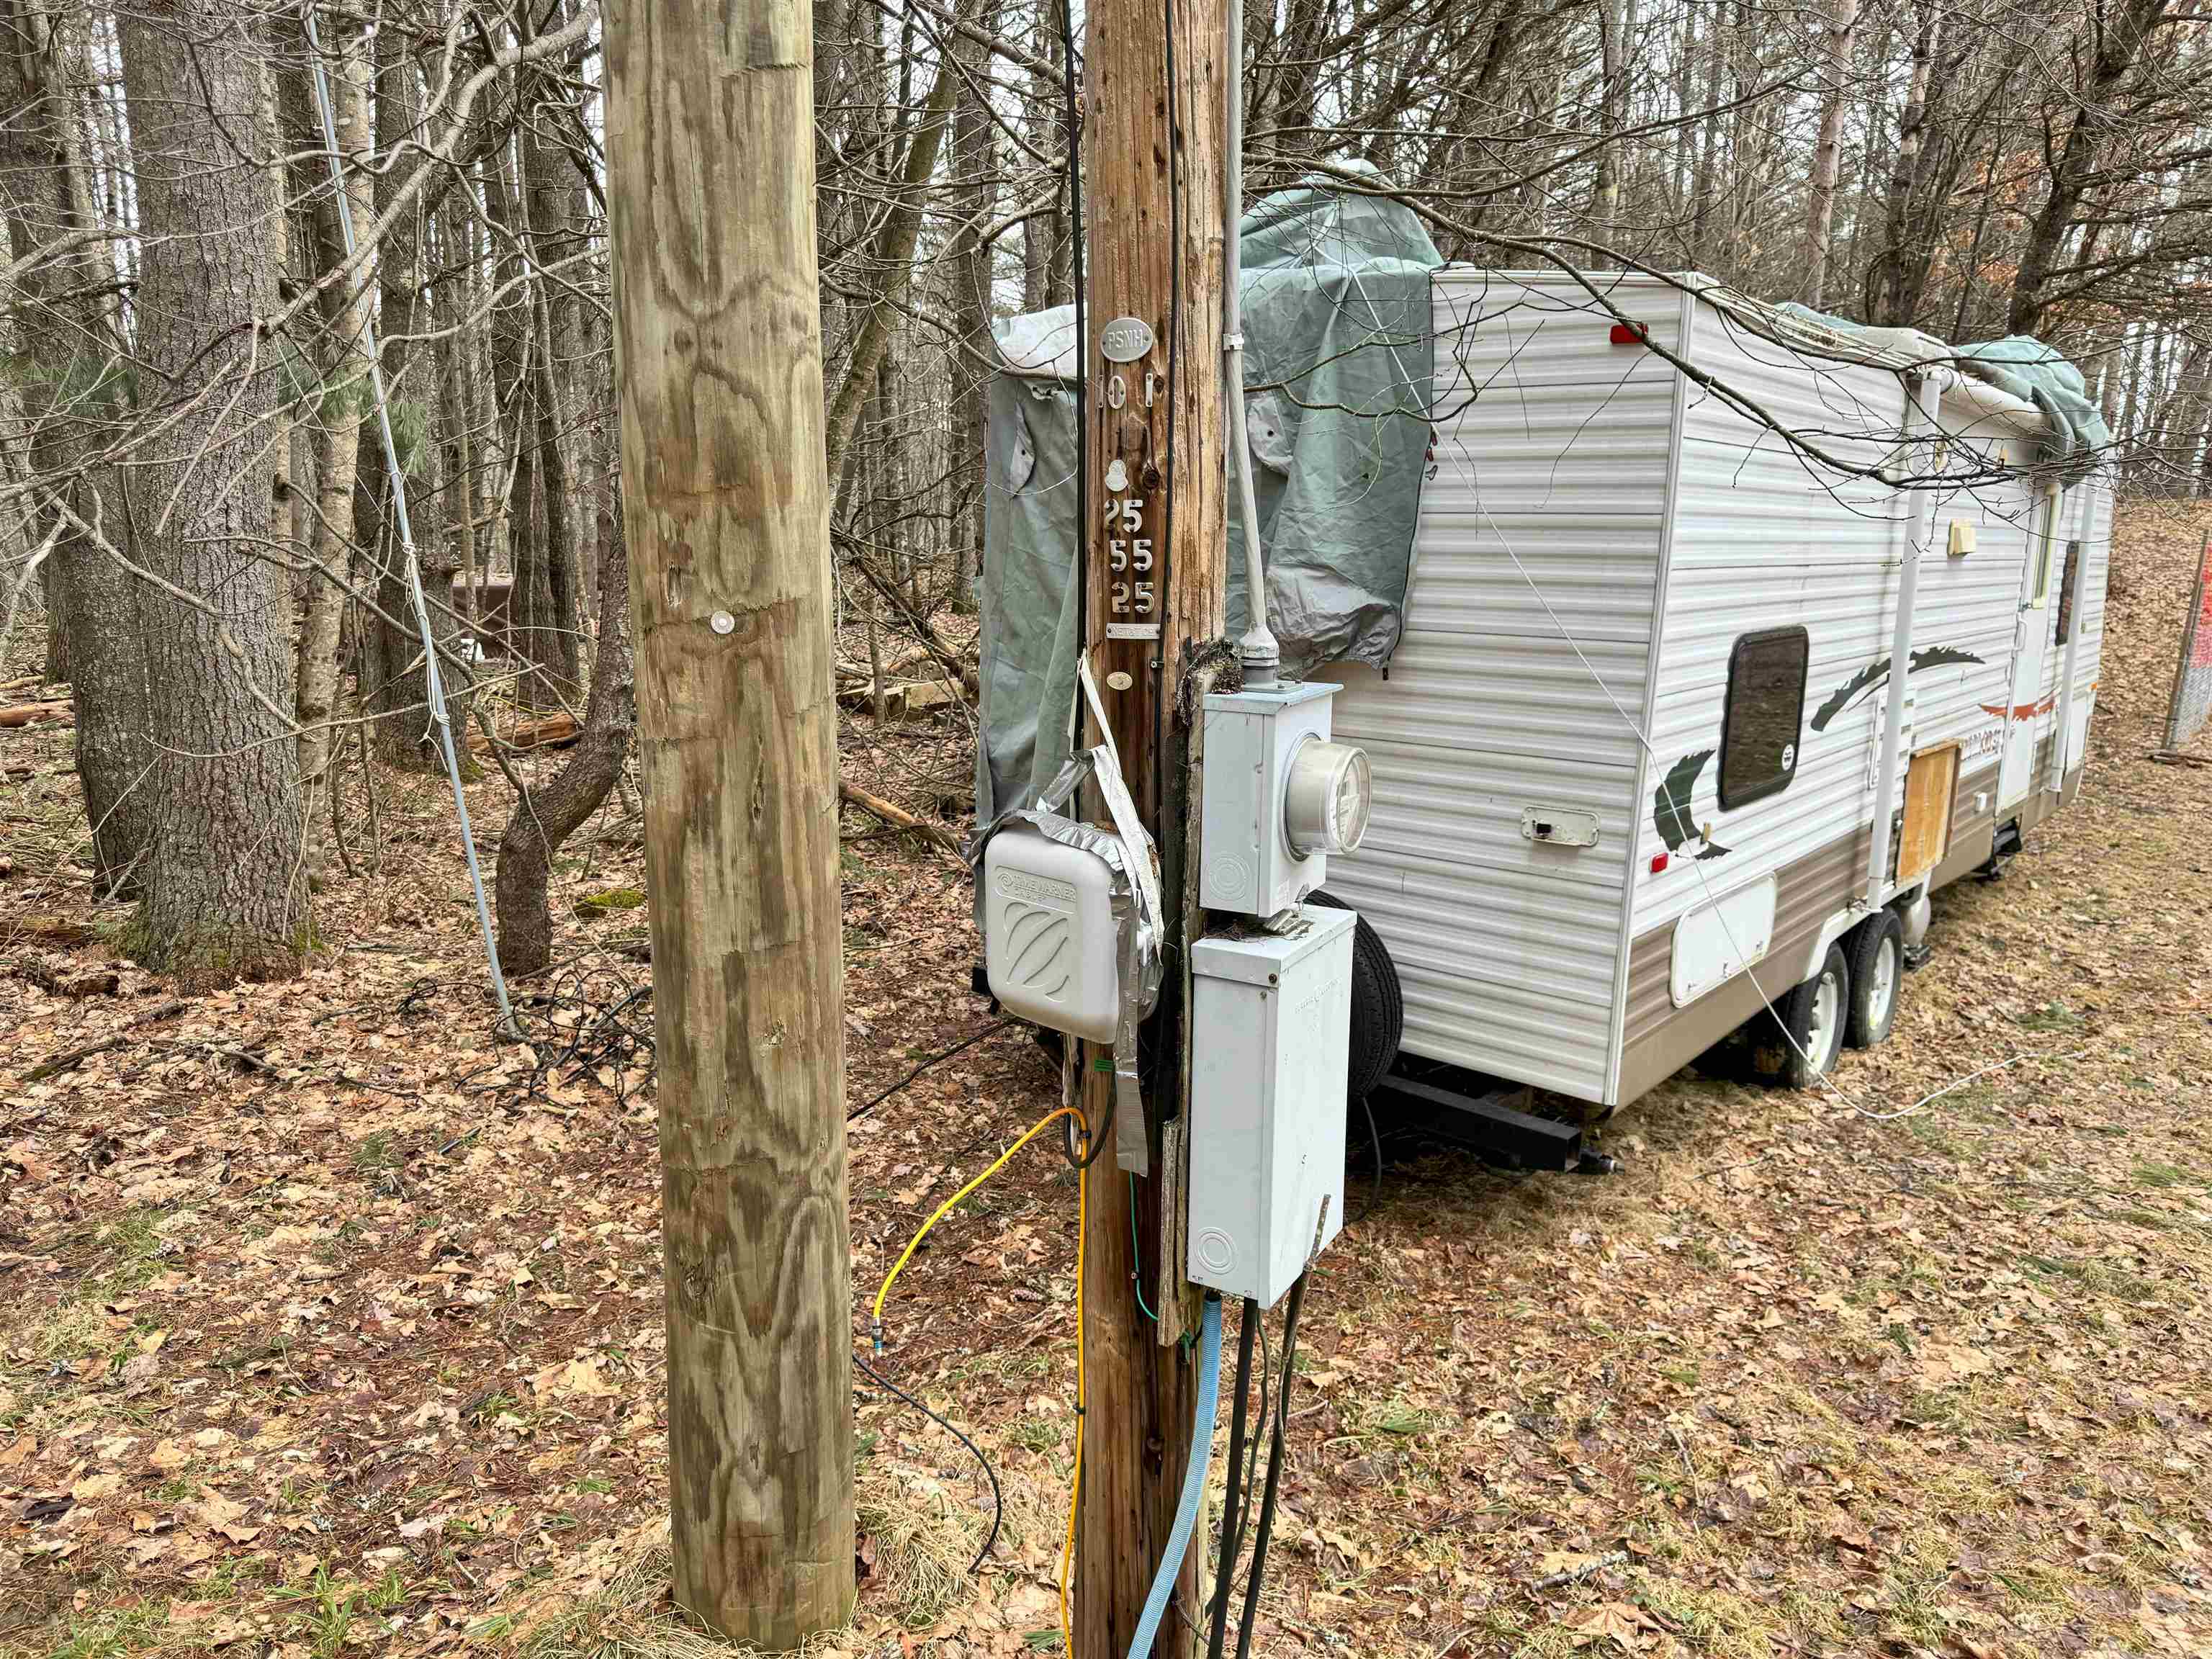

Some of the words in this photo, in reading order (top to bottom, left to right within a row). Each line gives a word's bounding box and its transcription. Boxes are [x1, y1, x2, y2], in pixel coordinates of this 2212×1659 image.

[1107, 329, 1143, 350] PSNH
[1104, 499, 1143, 533] 25
[1110, 539, 1153, 572] 55
[1111, 582, 1154, 613] 25
